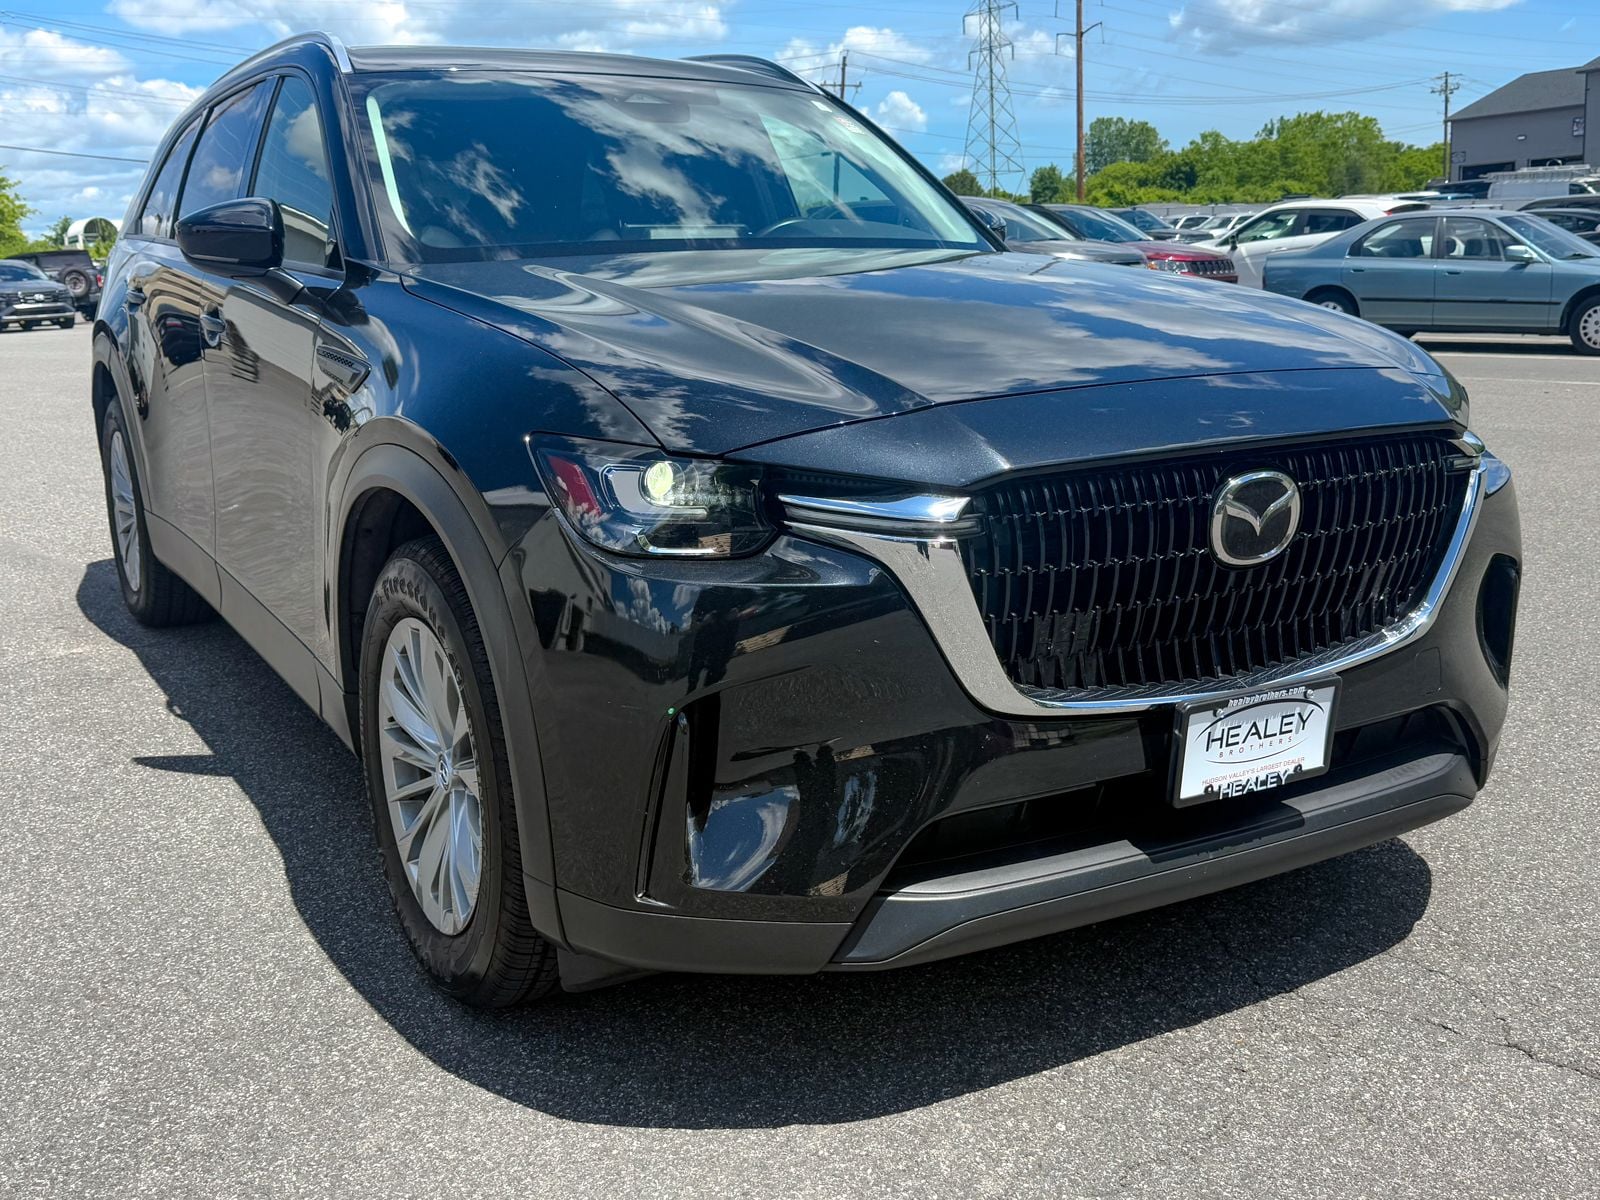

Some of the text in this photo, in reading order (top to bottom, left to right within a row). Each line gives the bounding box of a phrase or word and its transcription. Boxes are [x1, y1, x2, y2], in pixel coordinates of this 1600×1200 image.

[1228, 686, 1306, 708] healeybrothers.com
[1206, 709, 1314, 752] HEALEY
[1219, 736, 1292, 758] BROTHERS
[1202, 756, 1305, 786] HUDSON VALLEY'S LARGEST DEALER
[1218, 769, 1289, 800] HEALEY
